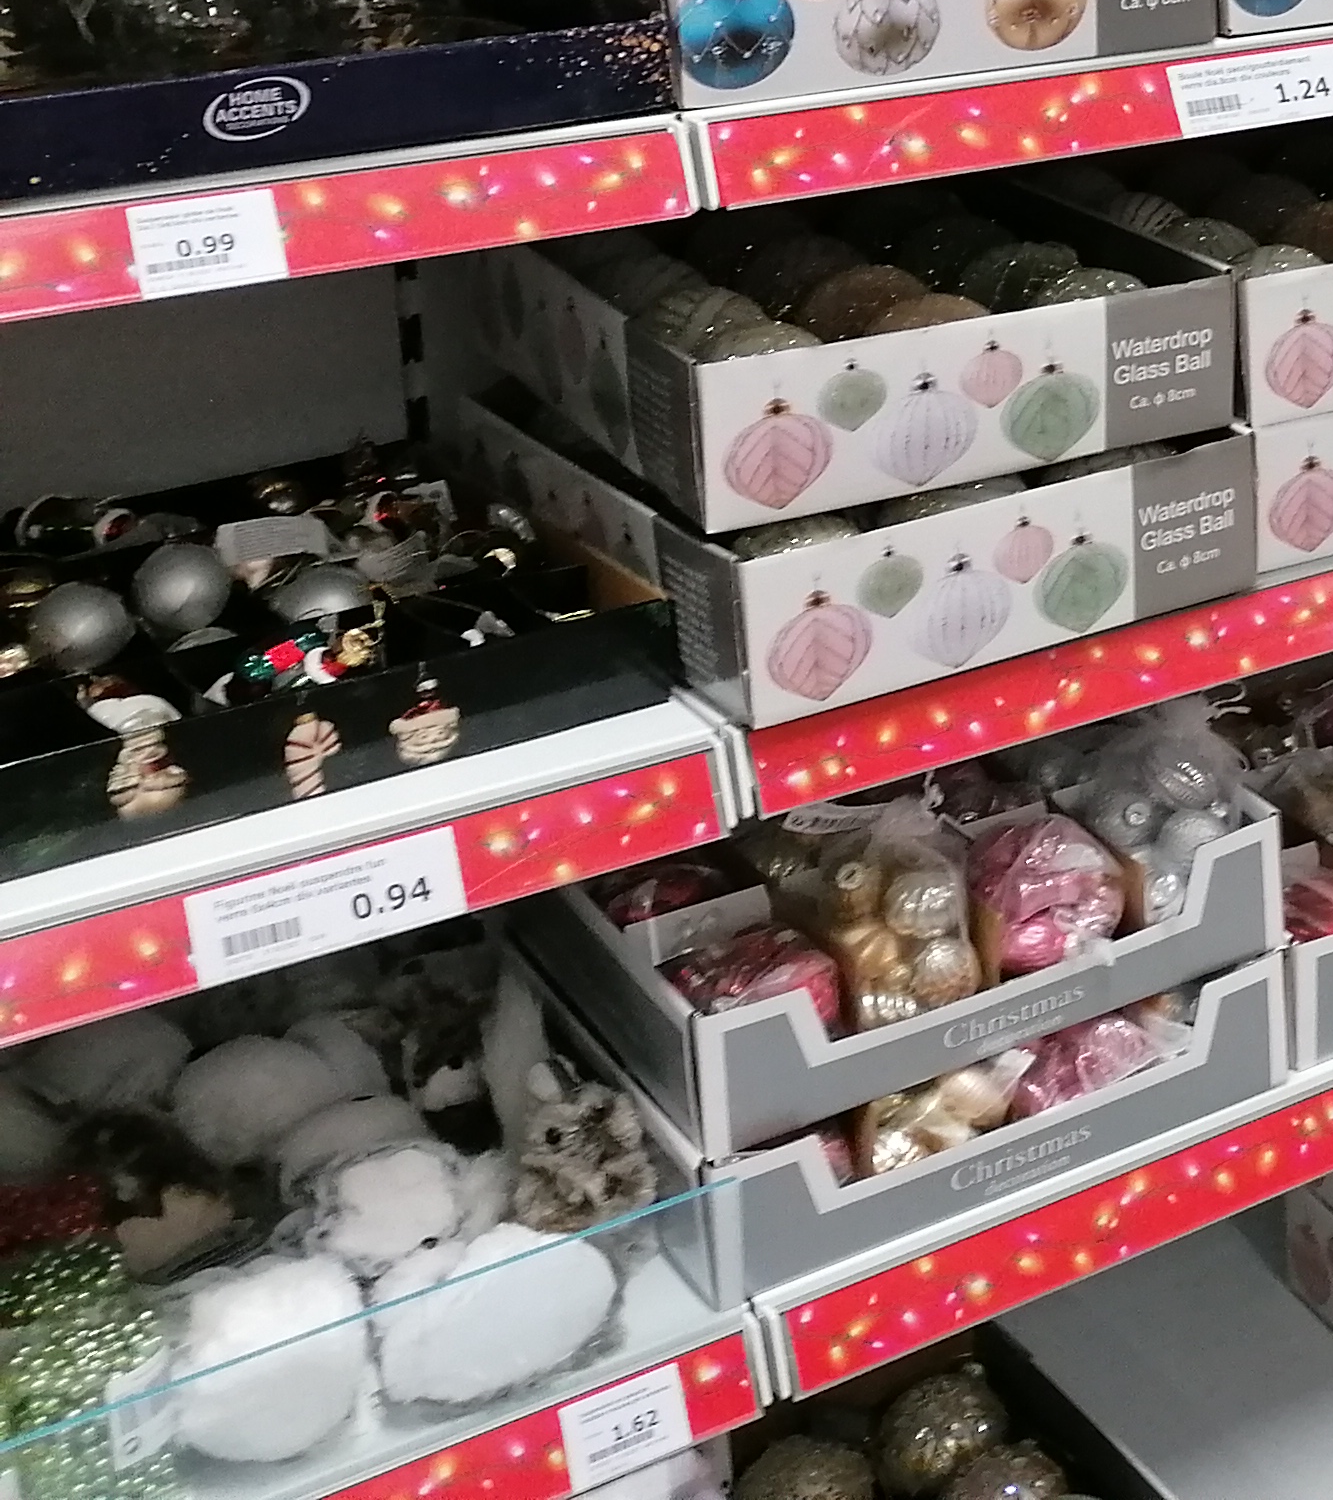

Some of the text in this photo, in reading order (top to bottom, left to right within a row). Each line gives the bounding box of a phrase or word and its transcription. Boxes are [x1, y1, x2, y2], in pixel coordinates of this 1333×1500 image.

[228, 86, 283, 107] HOME
[1274, 77, 1330, 103] 1.24
[216, 100, 298, 124] ACCENTS
[176, 233, 234, 257] 0.99
[1111, 327, 1213, 360] Waterdrop
[1113, 349, 1212, 385] Glass Ball
[1166, 386, 1197, 402] 8cm
[1138, 487, 1236, 527] Waterdrop
[1140, 508, 1235, 551] Glass Ball
[352, 876, 431, 919] 0.94
[943, 986, 1085, 1048] Christmas
[951, 1125, 1092, 1191] Christmas
[612, 1409, 660, 1441] 1.62
